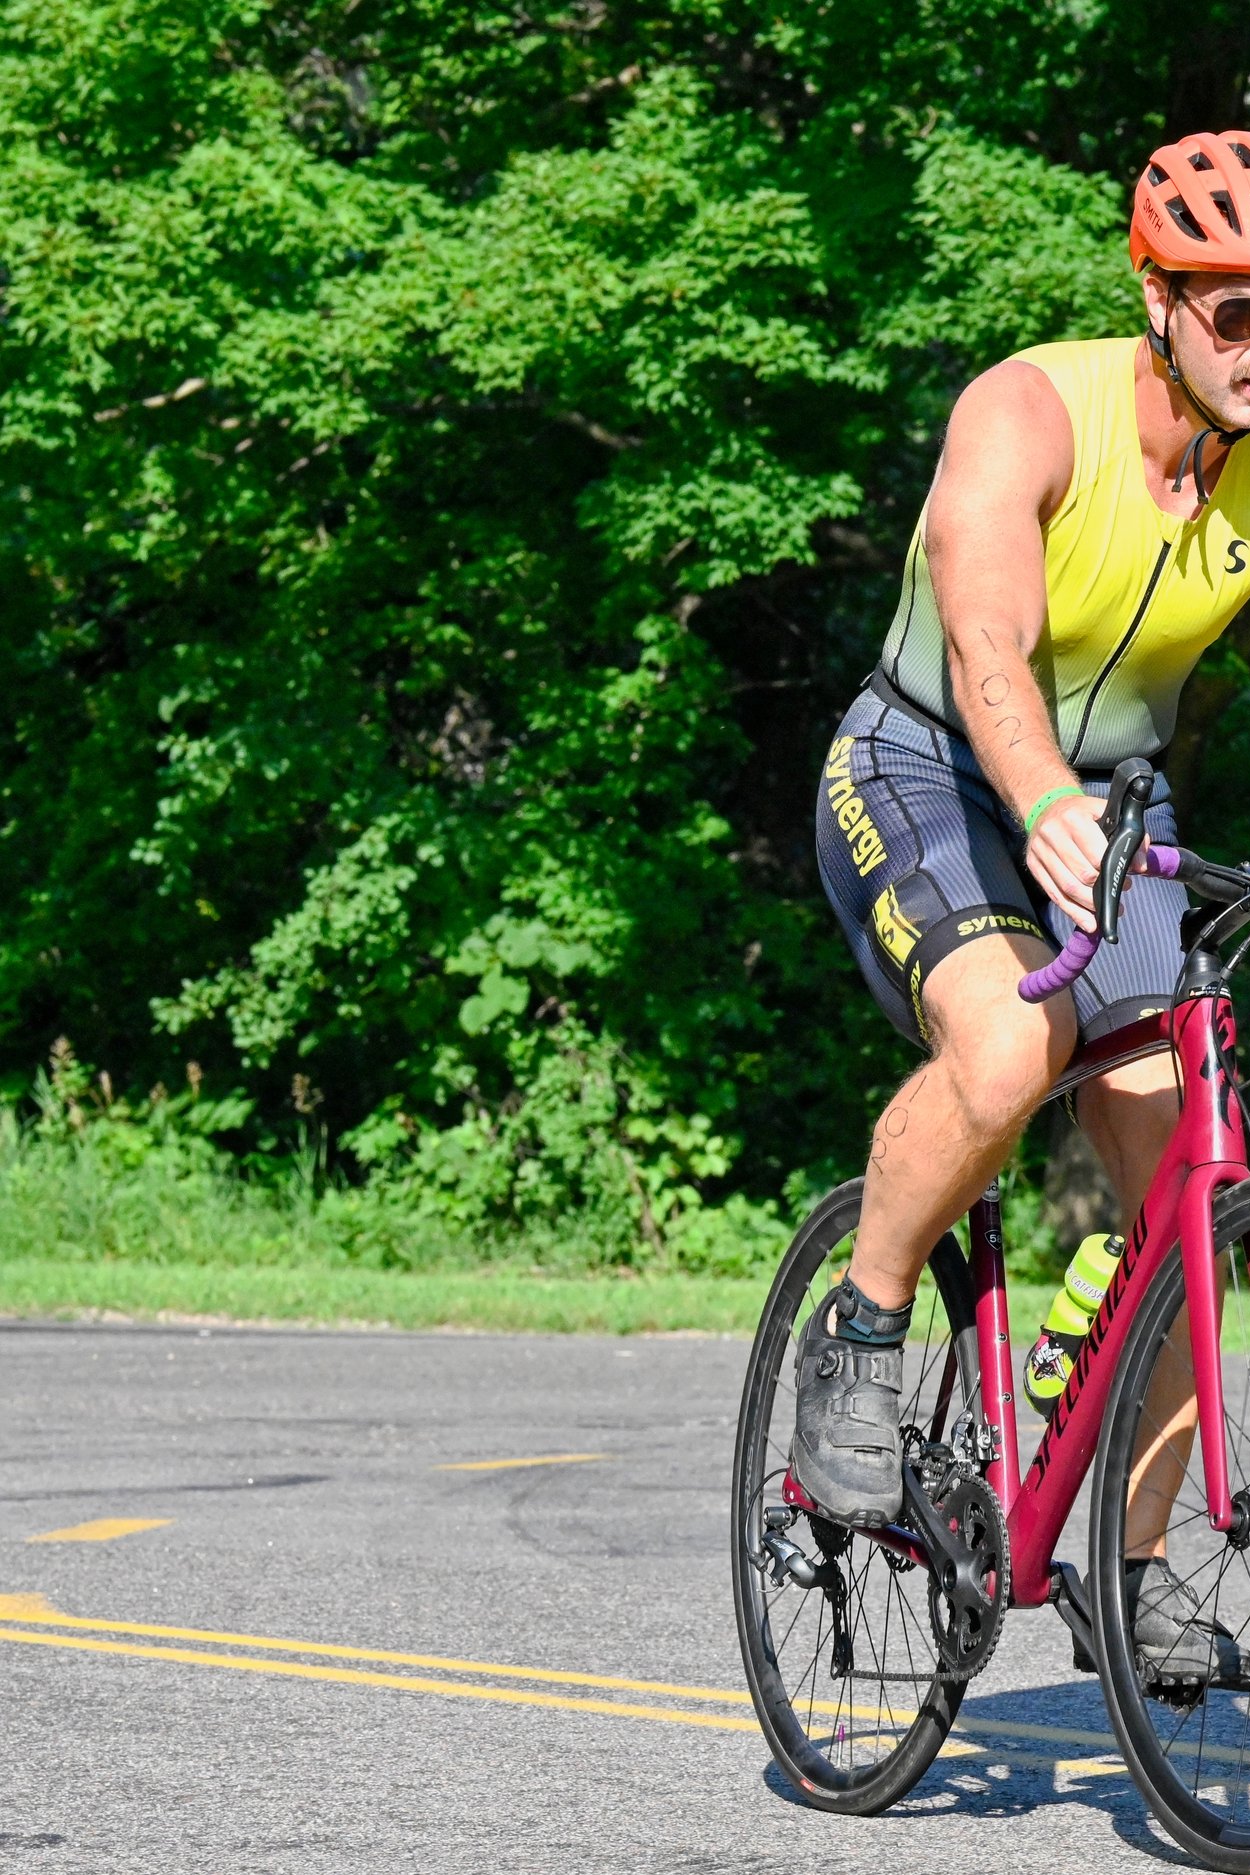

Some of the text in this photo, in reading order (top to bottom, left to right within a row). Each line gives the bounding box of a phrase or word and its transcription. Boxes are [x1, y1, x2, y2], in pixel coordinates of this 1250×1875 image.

[1142, 197, 1164, 233] SMITH
[826, 735, 888, 877] synergy
[1111, 855, 1128, 899] Tiagra
